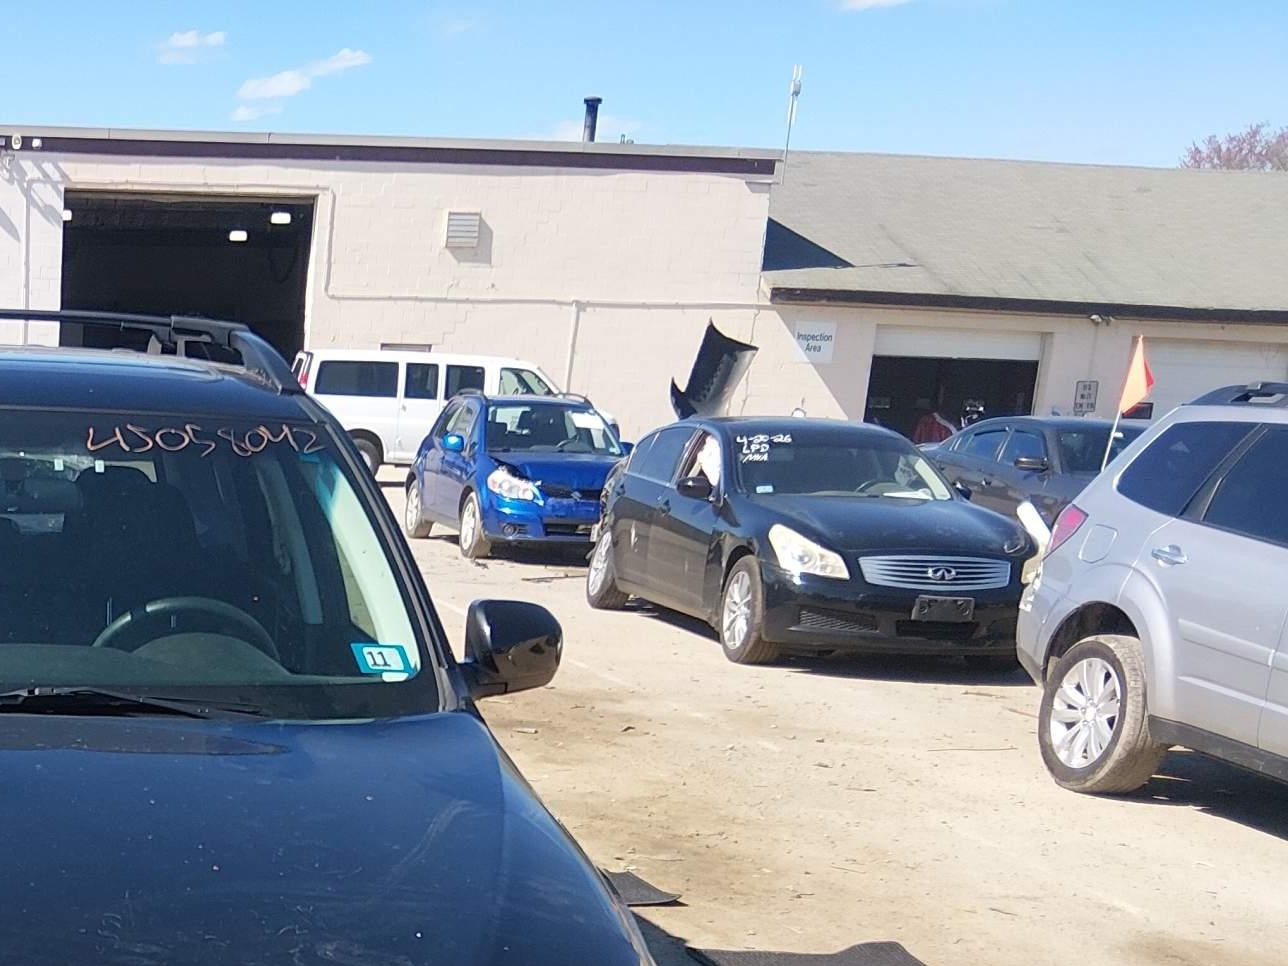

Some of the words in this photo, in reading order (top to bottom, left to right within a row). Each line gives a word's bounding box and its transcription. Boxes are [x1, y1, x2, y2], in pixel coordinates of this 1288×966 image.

[797, 332, 833, 342] Inspection
[805, 343, 822, 353] Area
[86, 423, 326, 458] 45058042
